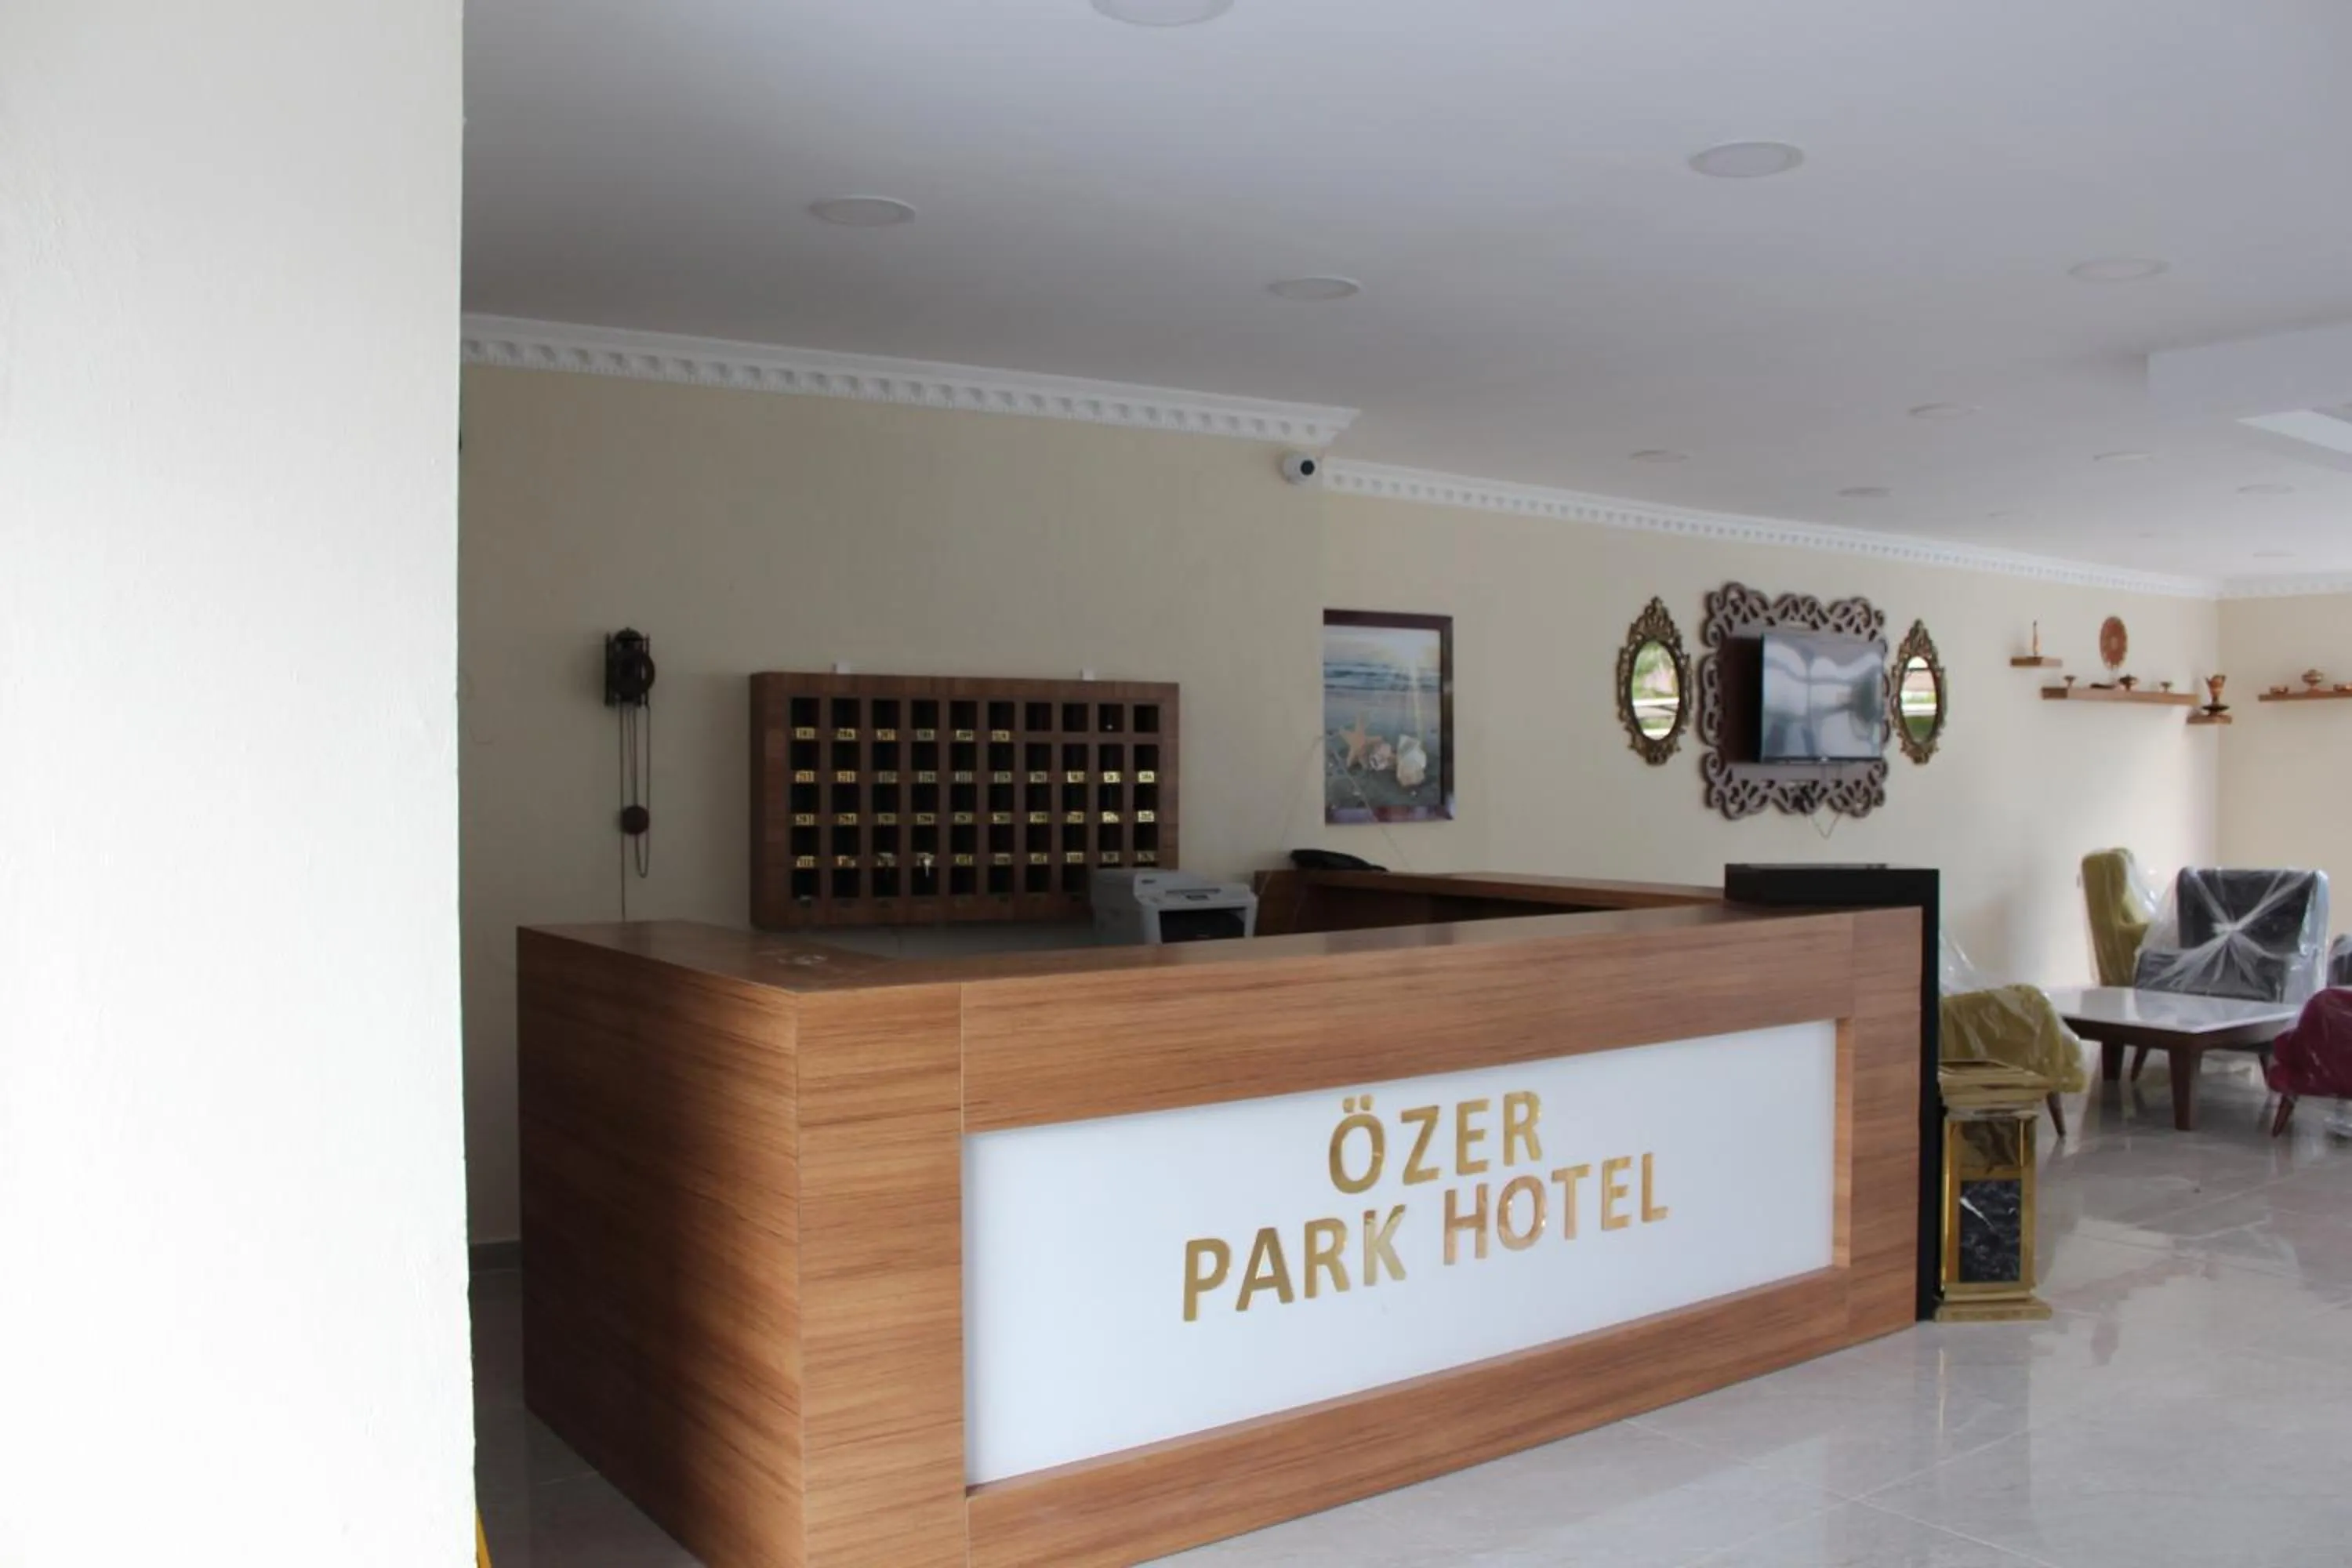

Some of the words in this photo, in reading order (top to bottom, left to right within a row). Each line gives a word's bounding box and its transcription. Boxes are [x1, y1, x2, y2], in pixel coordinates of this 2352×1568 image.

[1328, 1090, 1543, 1194] ÖZER
[1182, 1204, 1406, 1322] PARK
[1443, 1152, 1668, 1265] HOTEL
